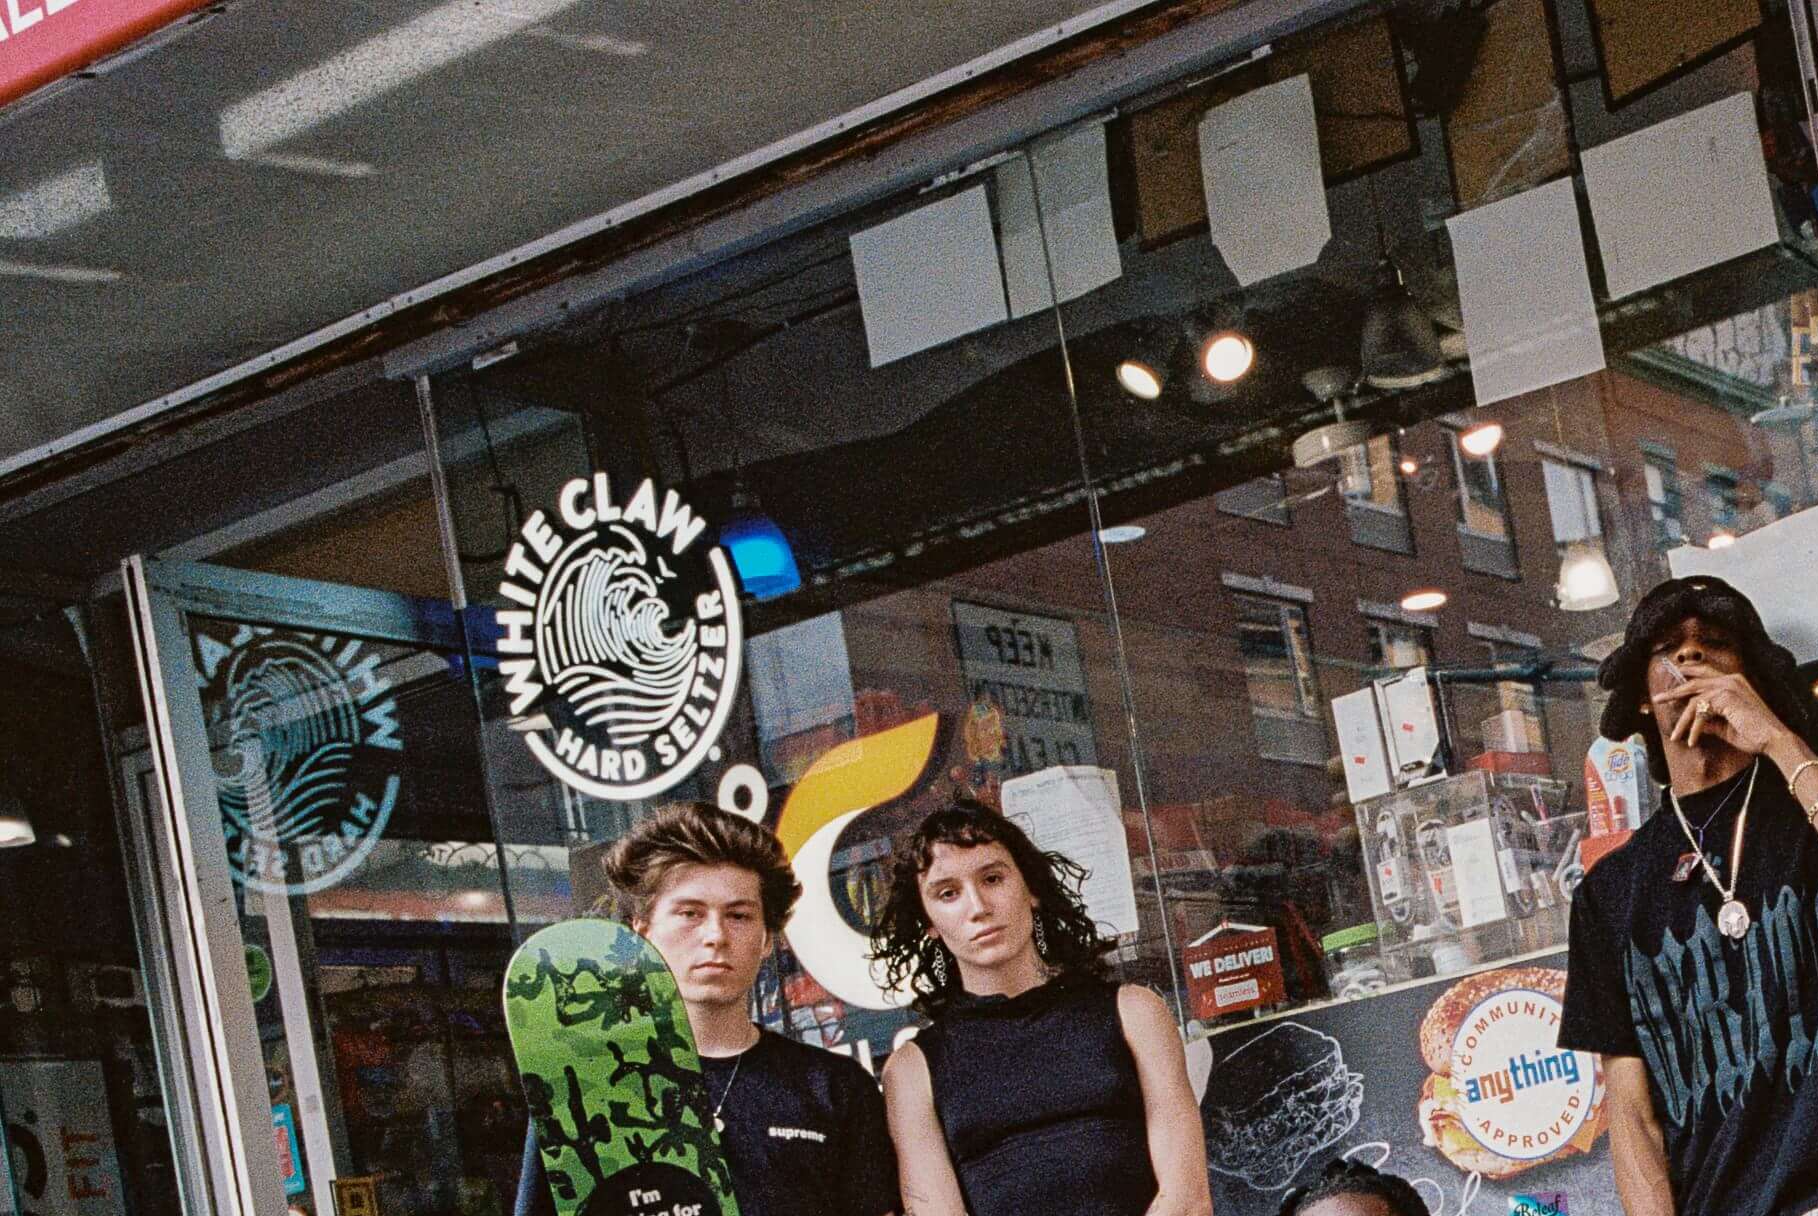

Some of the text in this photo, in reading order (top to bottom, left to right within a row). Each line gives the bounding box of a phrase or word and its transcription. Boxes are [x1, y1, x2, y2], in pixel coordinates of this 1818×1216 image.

[496, 472, 706, 715] WHITE CLAW
[556, 590, 726, 781] HARD SELTZER
[1189, 960, 1213, 979] WE
[1463, 1001, 1562, 1067] COMMUNIT
[1465, 1050, 1580, 1104] anything
[768, 1126, 825, 1142] supreme
[1479, 1094, 1581, 1148] APPROVED
[629, 1189, 661, 1207] I'm
